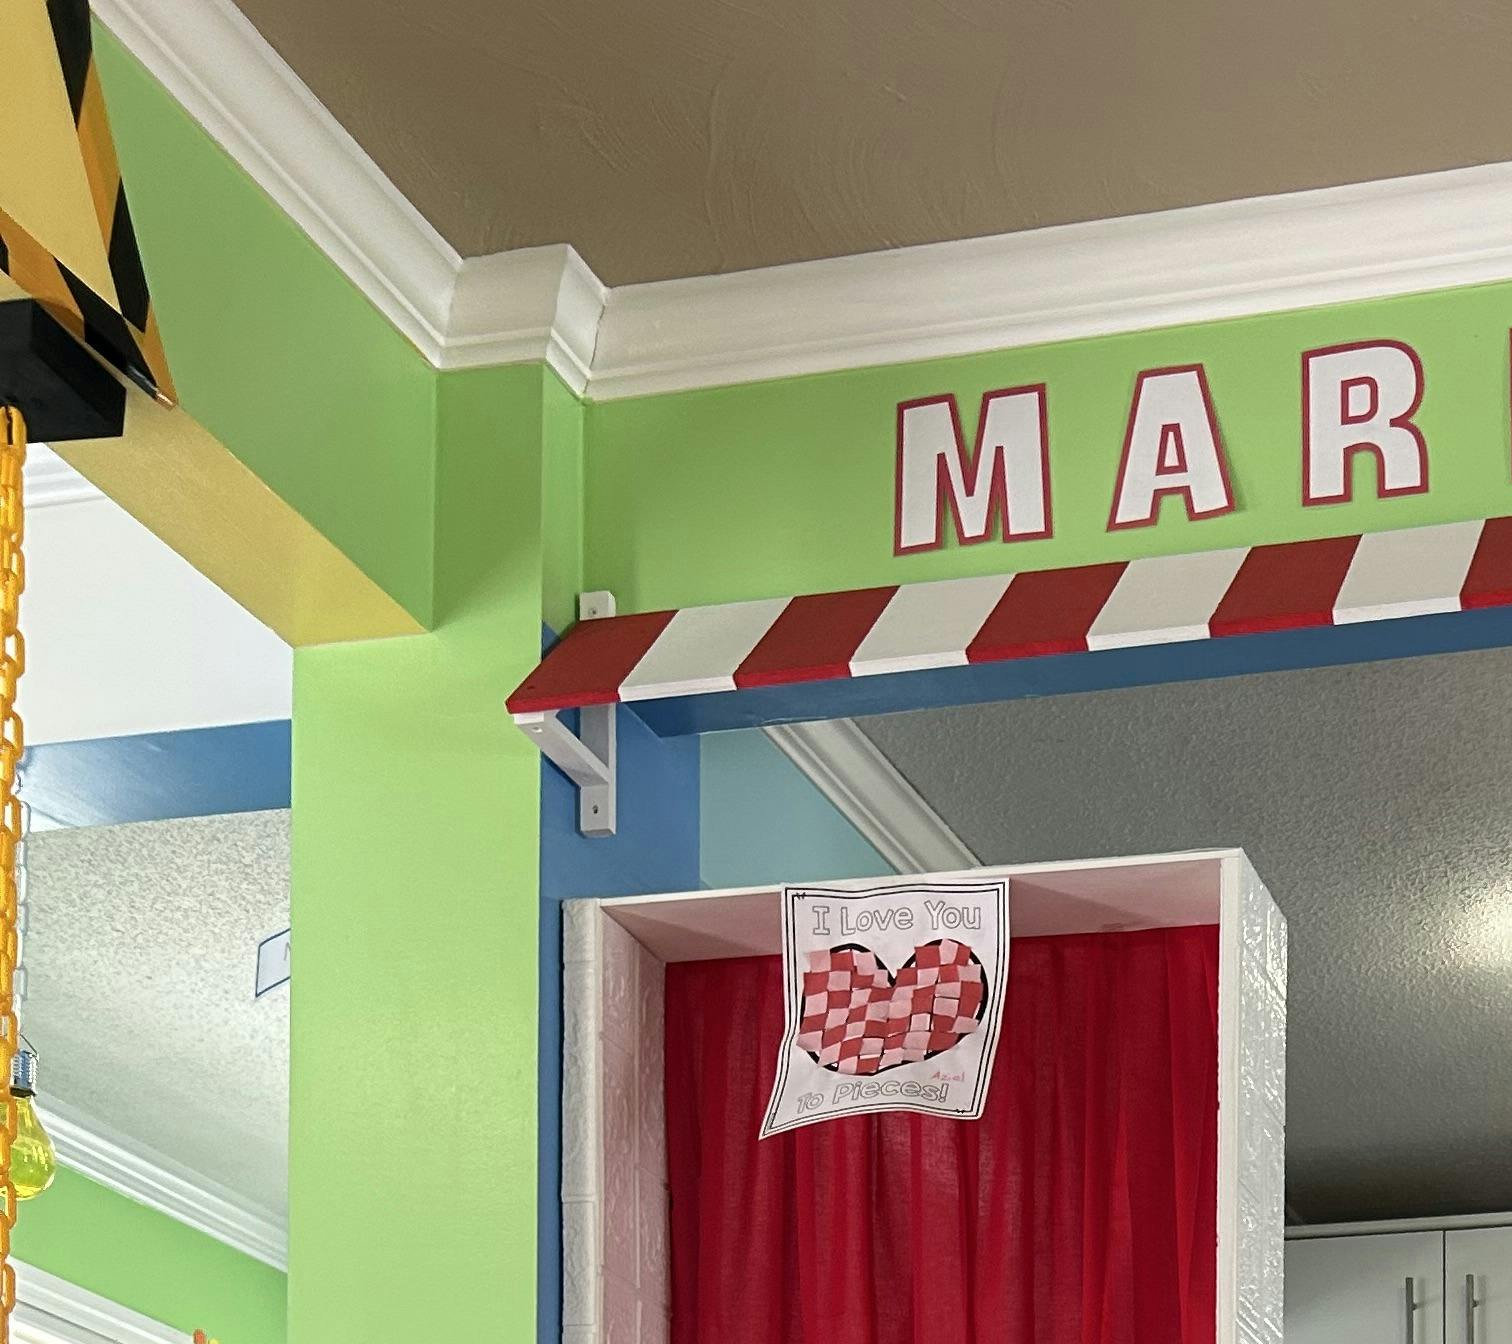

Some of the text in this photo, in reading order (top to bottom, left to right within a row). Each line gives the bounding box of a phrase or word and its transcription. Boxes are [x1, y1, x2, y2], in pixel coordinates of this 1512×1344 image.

[812, 899, 982, 936] I Love You
[796, 1080, 950, 1115] To Pieces!
